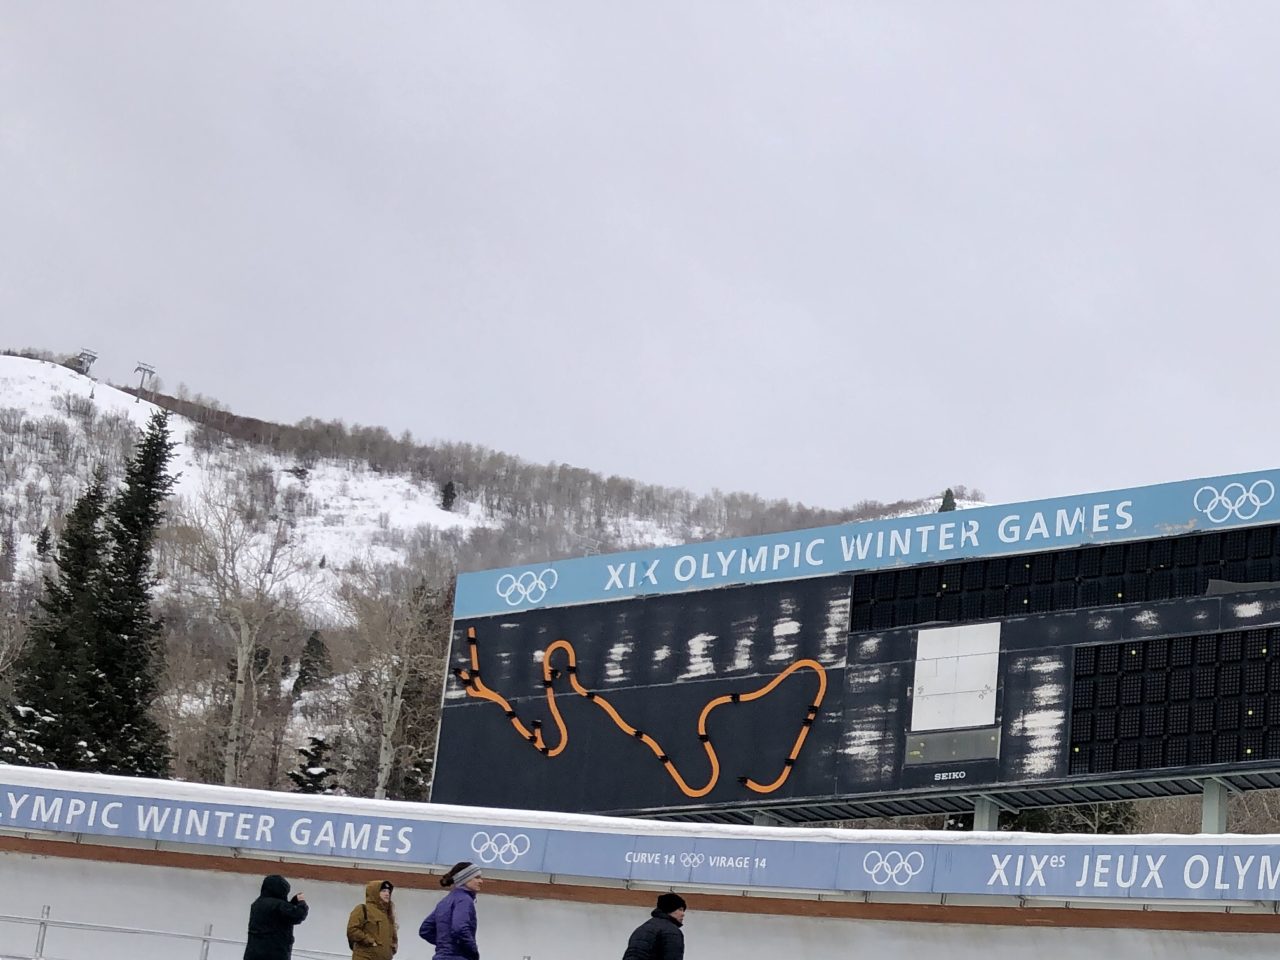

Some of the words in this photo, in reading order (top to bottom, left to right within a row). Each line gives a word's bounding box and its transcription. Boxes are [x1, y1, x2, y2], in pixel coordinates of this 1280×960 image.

[604, 559, 661, 591] XIX
[674, 538, 825, 582] OLYMPIC
[840, 520, 981, 562] WINTER
[997, 500, 1134, 544] GAMES
[934, 771, 967, 781] SEIKO
[0, 792, 122, 829] YMPIC
[138, 805, 274, 842] WINTER
[290, 816, 413, 855] GAMES
[625, 851, 661, 865] CURVE
[664, 854, 676, 866] 14
[709, 855, 750, 868] VIRAGE
[754, 857, 767, 869] 14
[1075, 854, 1168, 889] JEUX
